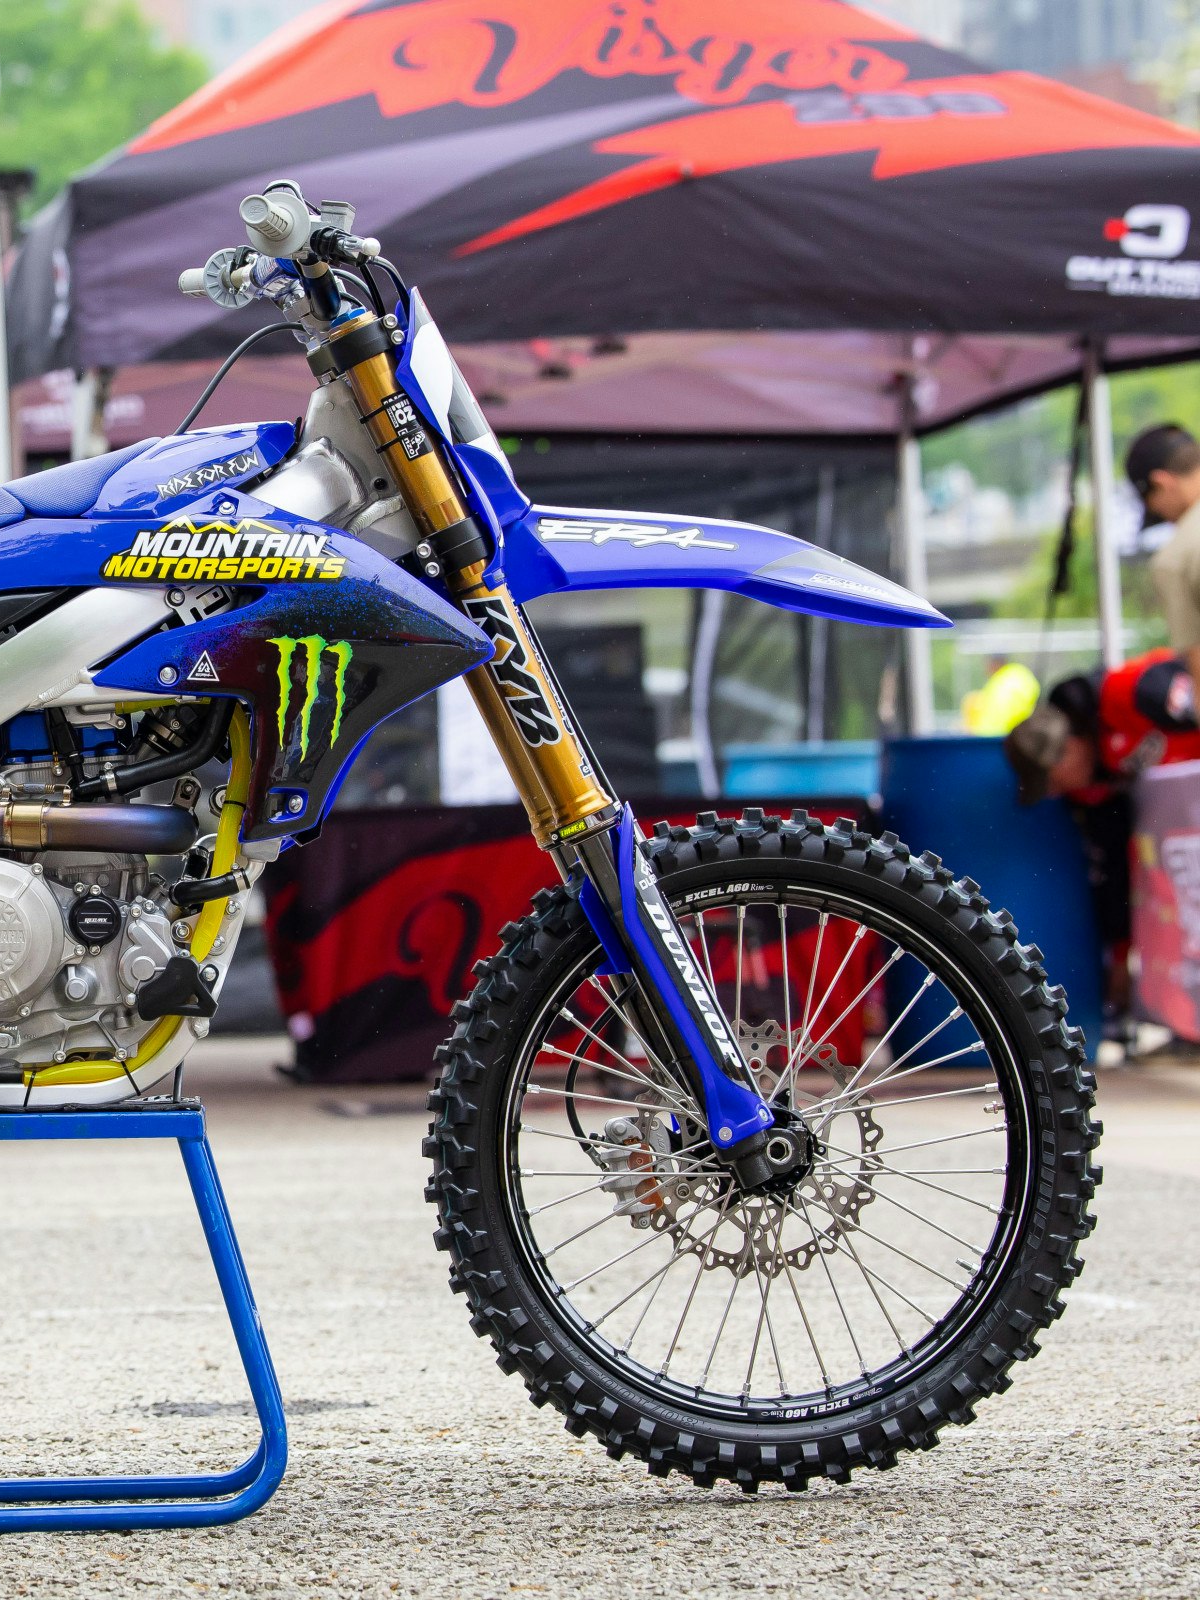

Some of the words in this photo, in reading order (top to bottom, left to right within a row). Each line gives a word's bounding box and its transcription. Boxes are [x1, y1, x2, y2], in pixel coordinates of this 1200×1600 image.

[157, 472, 198, 498] RIDE
[195, 464, 229, 485] FOR
[227, 451, 259, 475] FUN
[131, 532, 329, 557] MOUNTAIN
[104, 556, 347, 579] MOTORSPORTS
[685, 887, 725, 902] EXCEL
[726, 883, 750, 893] A60
[751, 883, 770, 891] Rim
[643, 901, 742, 1068] DUNLOP
[785, 1409, 808, 1419] A60
[810, 1398, 851, 1414] EXCEL
